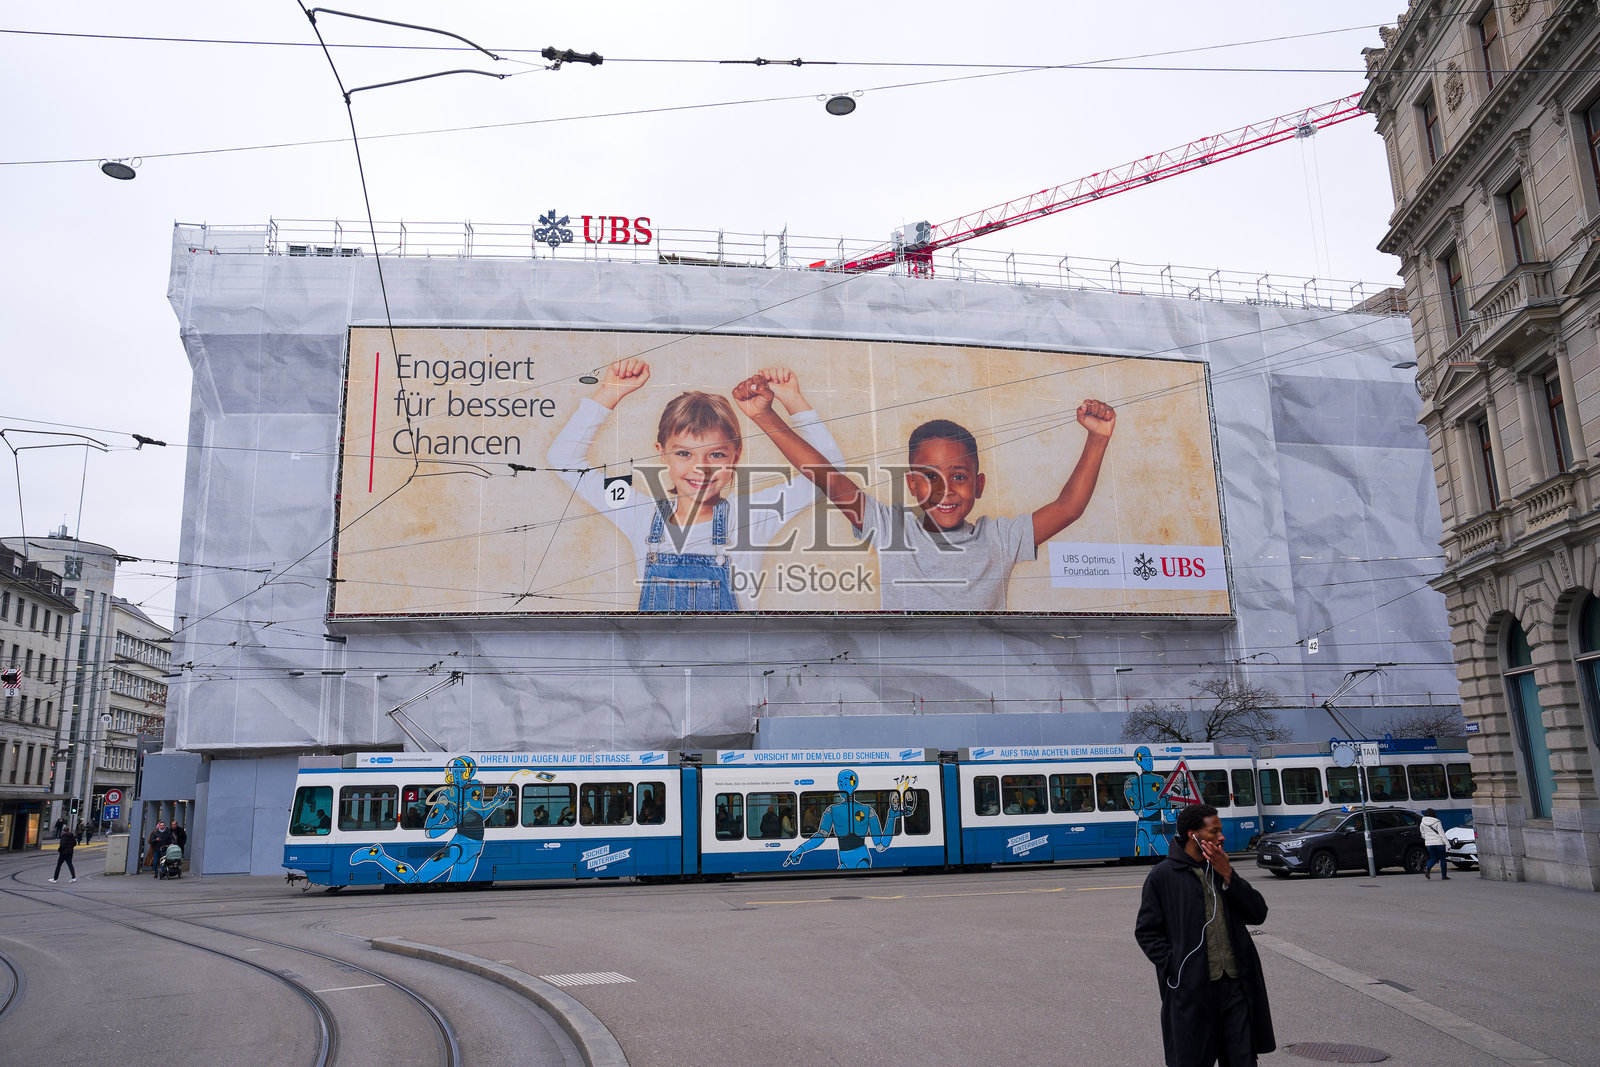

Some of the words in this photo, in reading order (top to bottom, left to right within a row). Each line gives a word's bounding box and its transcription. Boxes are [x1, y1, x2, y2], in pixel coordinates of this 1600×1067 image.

[581, 215, 652, 245] UBS
[397, 353, 535, 386] Engagiert
[393, 389, 436, 417] für
[447, 390, 556, 418] bessere
[392, 427, 521, 455] Chancen
[610, 487, 625, 501] 12
[1062, 554, 1080, 564] UBS
[1082, 554, 1116, 565] Optimus
[1064, 566, 1110, 576] Foundation
[1160, 556, 1206, 578] UBS
[1310, 642, 1318, 650] 42
[754, 752, 789, 760] VORSICHT
[855, 752, 891, 760] SCHIENEN.
[1090, 747, 1126, 755] ABBIEGEN.
[1362, 748, 1378, 756] TAXI
[480, 754, 508, 763] OHREN
[512, 754, 528, 763] UND
[532, 754, 558, 762] AUGEN
[562, 754, 576, 762] AUF
[580, 754, 593, 762] DIE
[595, 754, 632, 762] STRASSE.
[408, 792, 414, 800] 2
[1010, 834, 1030, 845] SICHER
[1014, 838, 1046, 852] UNTERWEGS
[586, 846, 608, 858] SICHER
[589, 850, 626, 868] UNTERWEGS
